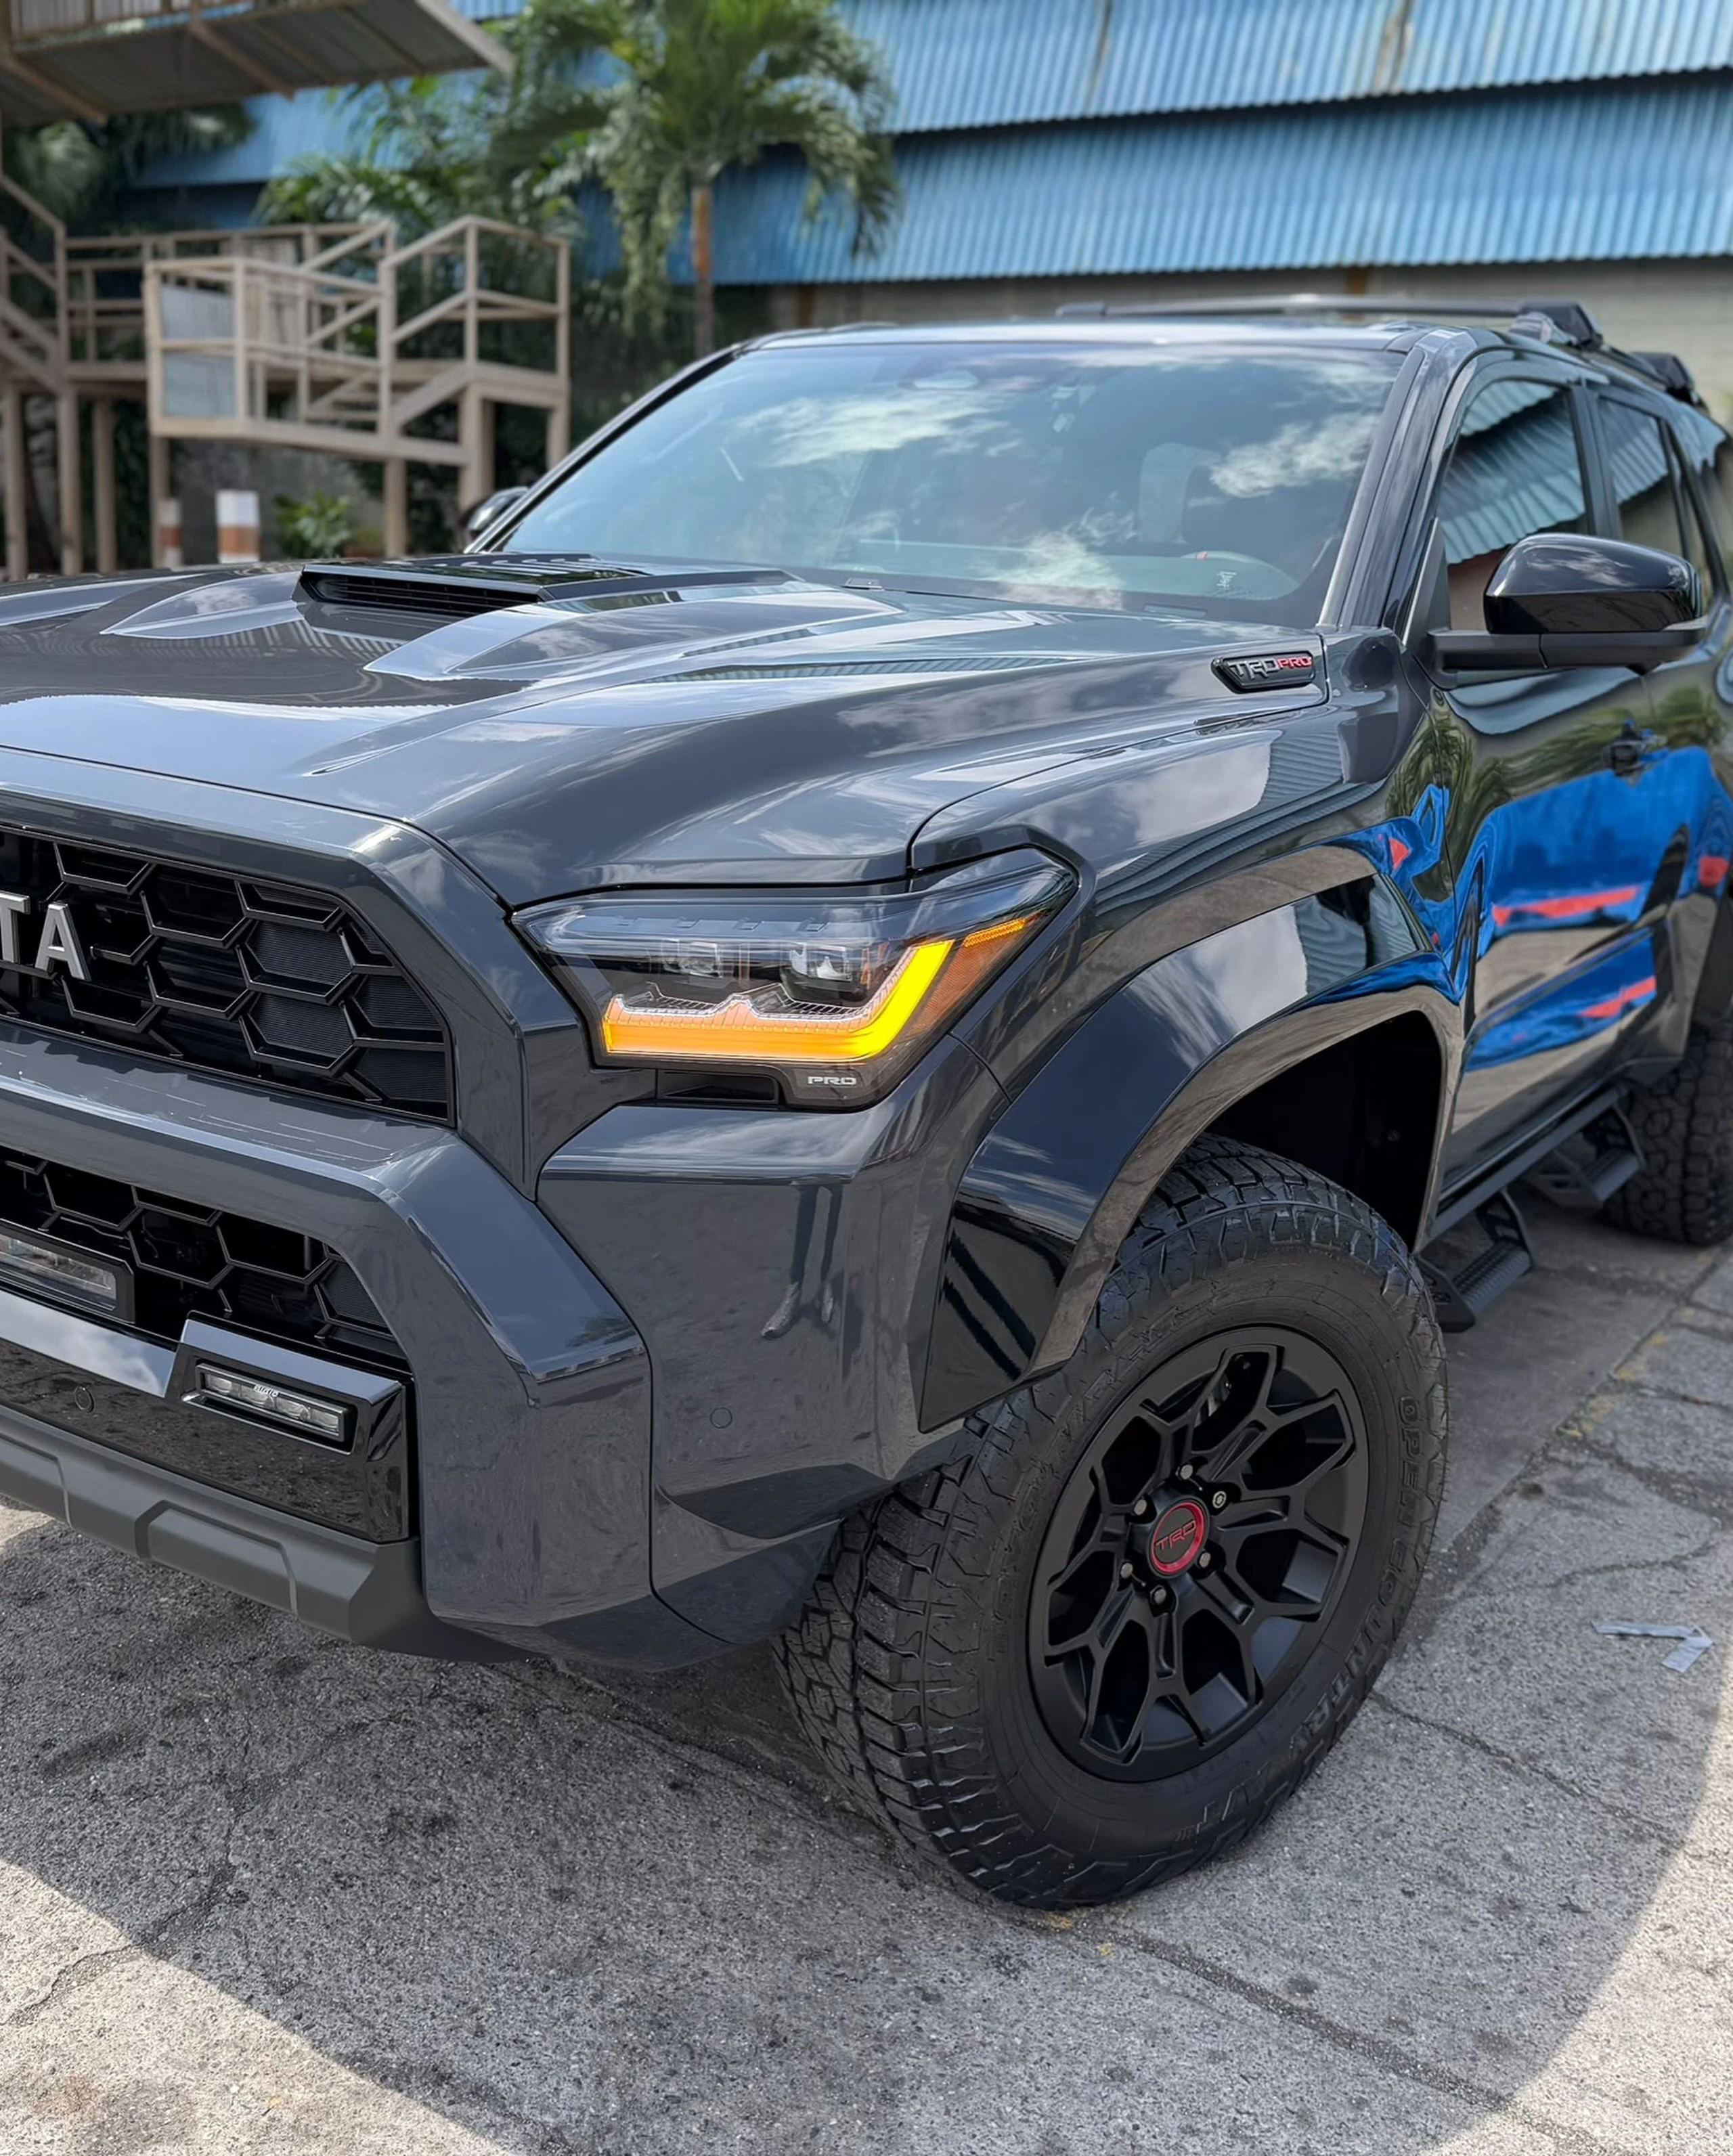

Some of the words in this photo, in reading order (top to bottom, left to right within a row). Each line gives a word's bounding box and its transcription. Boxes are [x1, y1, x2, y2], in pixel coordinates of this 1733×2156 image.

[1227, 658, 1280, 680] TRD
[1278, 656, 1313, 670] PRO
[0, 890, 91, 982] TA
[807, 1076, 856, 1086] PRO
[1156, 1519, 1197, 1552] TRD
